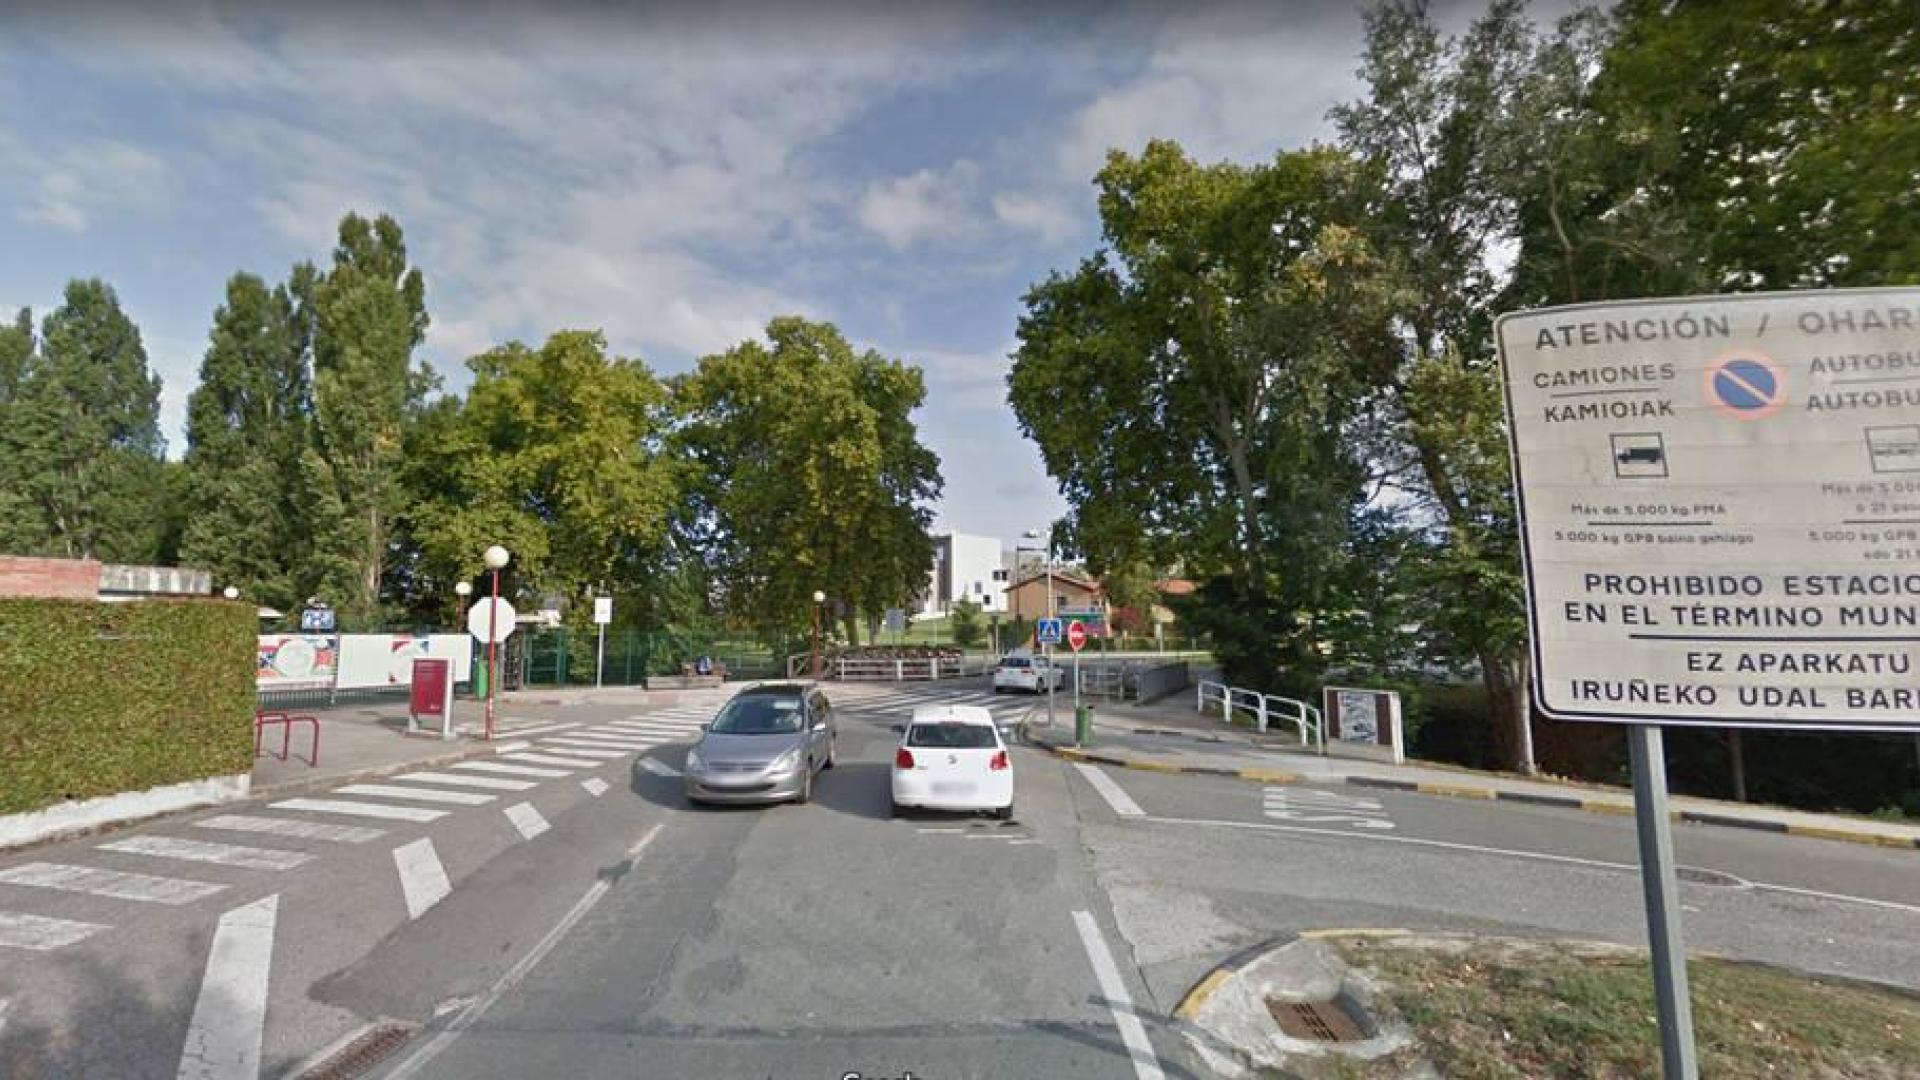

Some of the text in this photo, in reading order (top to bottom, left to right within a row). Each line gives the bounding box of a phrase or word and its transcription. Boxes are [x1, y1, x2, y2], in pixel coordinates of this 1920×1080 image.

[1536, 311, 1730, 350] ATENCIÓN
[1797, 308, 1920, 335] OHAR
[1533, 363, 1676, 388] CAMIONES
[1544, 399, 1676, 423] KAMIOIAK
[1603, 504, 1619, 516] de
[1584, 573, 1920, 596] PROHIBIDO ESTACIO
[1564, 600, 1917, 627] EN EL TÉRMINO MUN
[1687, 651, 1910, 674] EZ APARKATU
[1571, 678, 1920, 710] IRUÑEKO UDAL BAR
